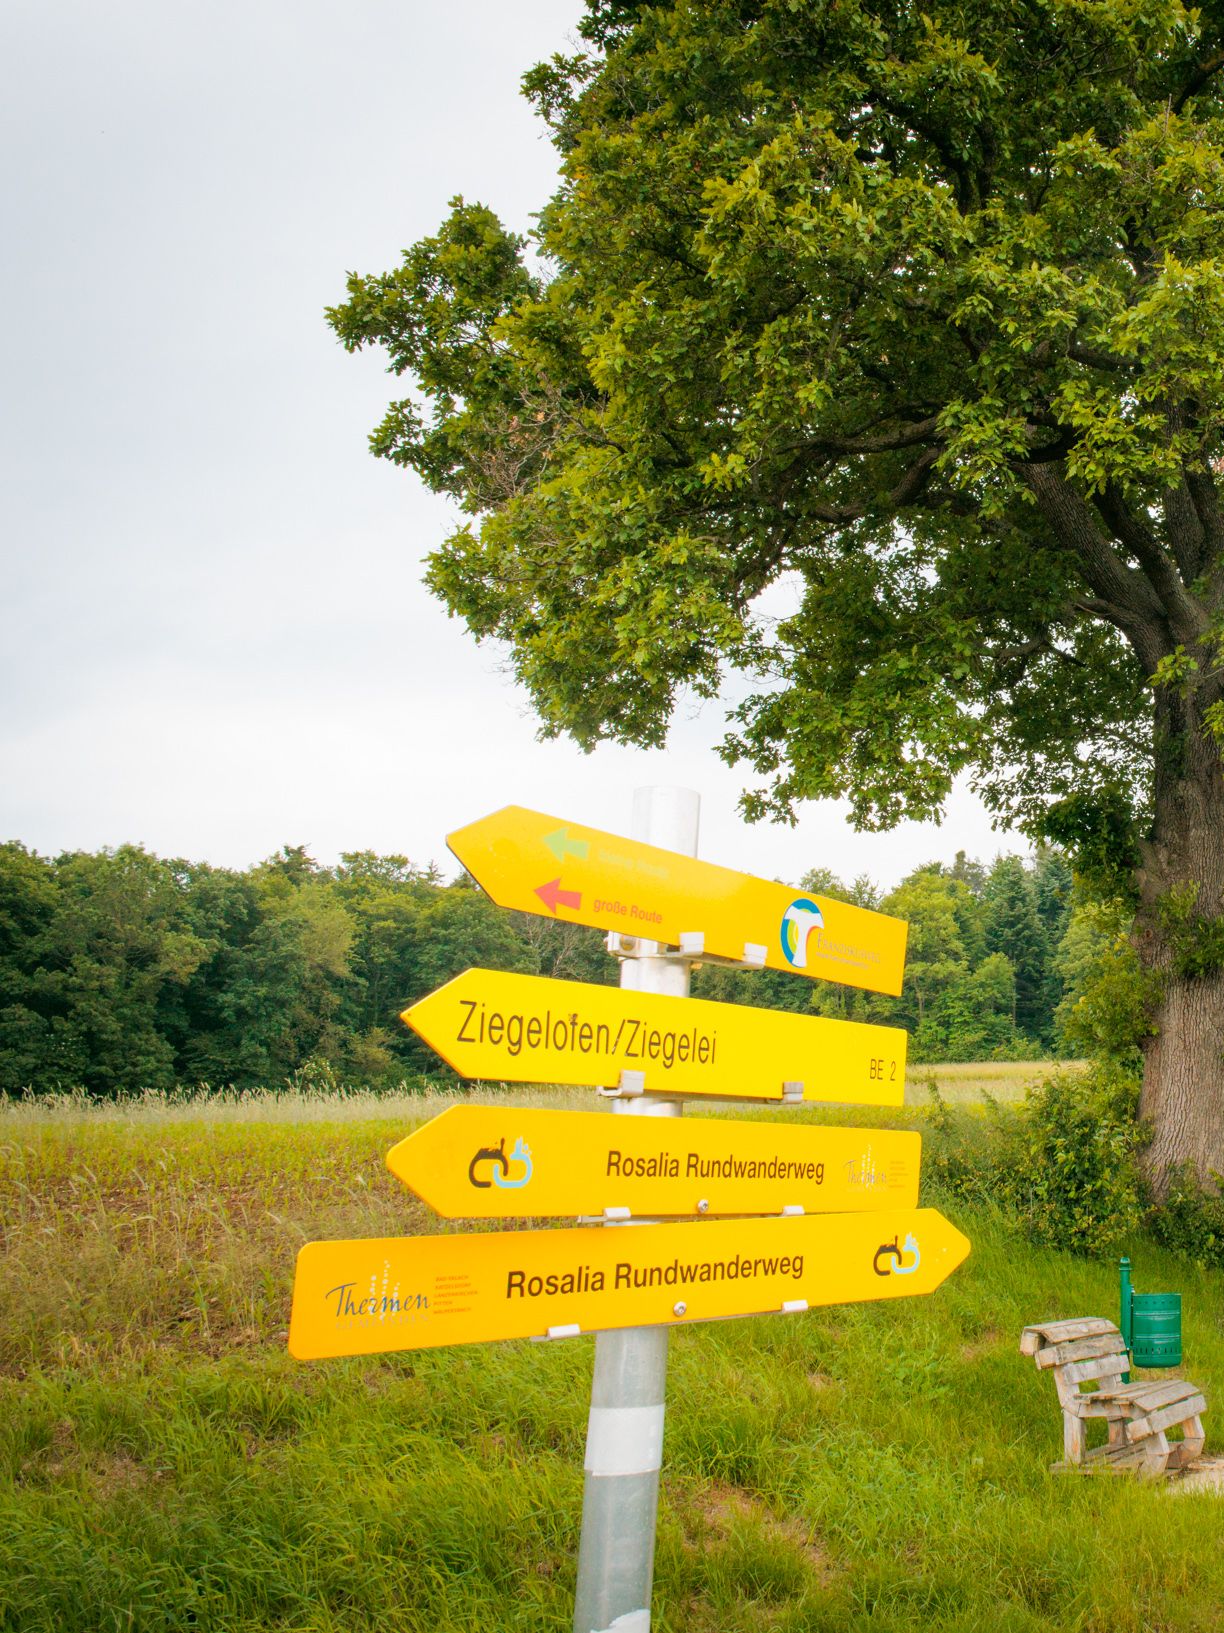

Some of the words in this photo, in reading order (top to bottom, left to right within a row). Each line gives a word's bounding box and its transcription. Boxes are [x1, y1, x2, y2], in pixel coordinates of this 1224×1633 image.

[593, 899, 627, 915] große
[630, 905, 663, 924] Route
[869, 1058, 884, 1081] BE
[889, 1060, 896, 1082] 2
[606, 1150, 680, 1178] Rosalia
[686, 1152, 825, 1186] Rundwanderweg
[507, 1265, 605, 1299] Rosalia
[614, 1254, 804, 1290] Rundwanderweg
[325, 1283, 430, 1317] Thermen
